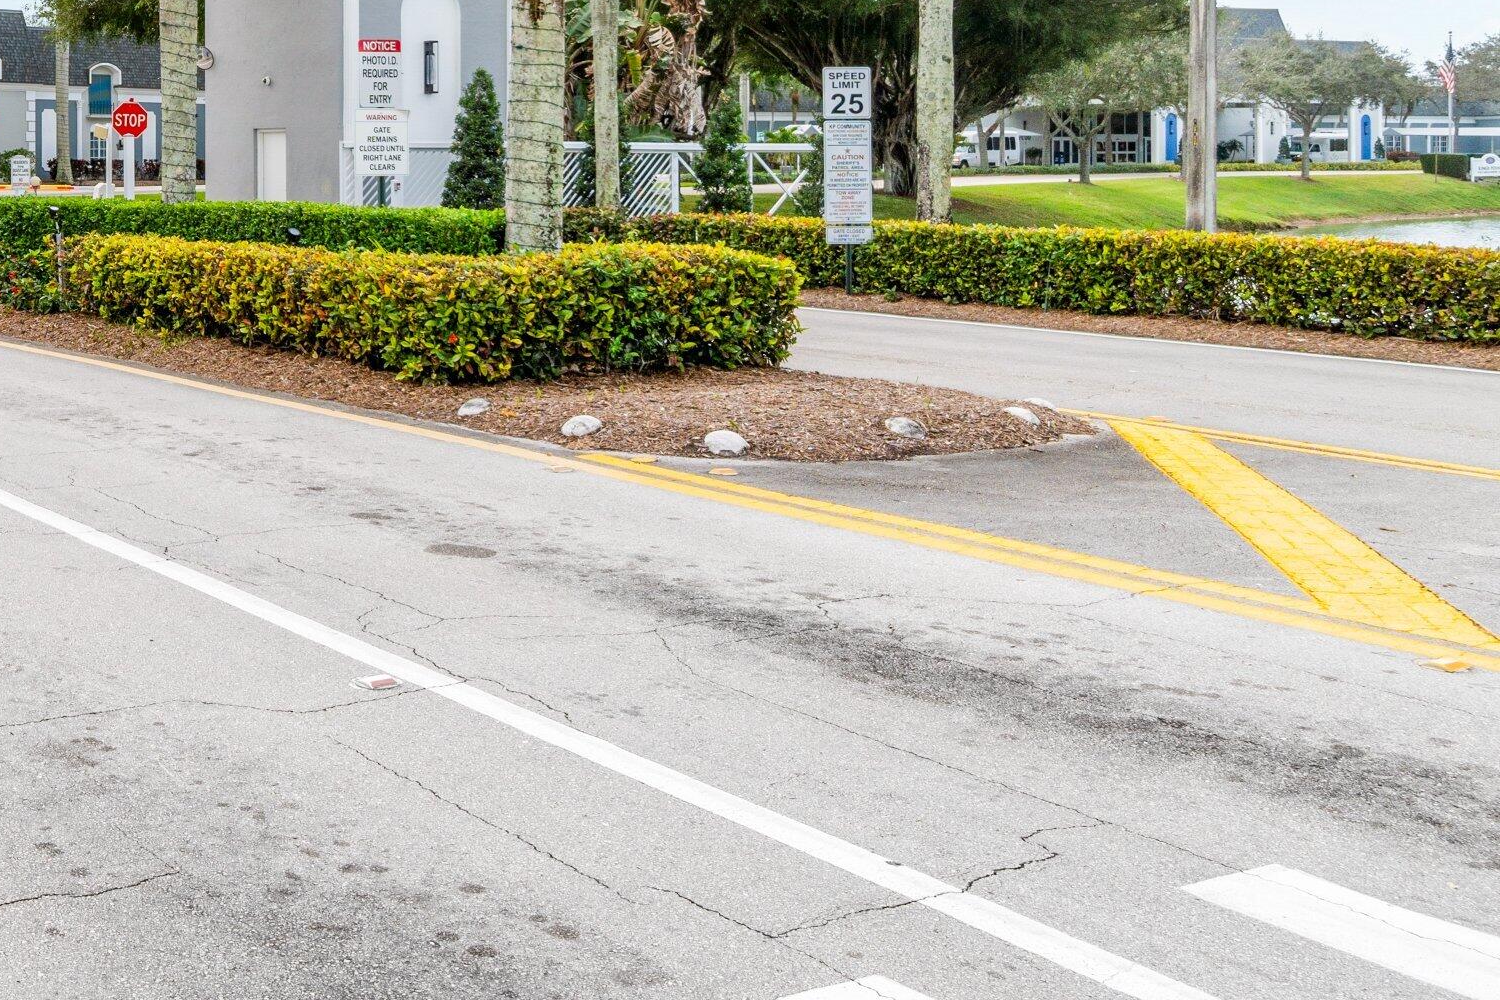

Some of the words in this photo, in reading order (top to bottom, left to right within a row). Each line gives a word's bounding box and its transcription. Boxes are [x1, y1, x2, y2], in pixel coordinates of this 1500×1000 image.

[362, 41, 397, 51] NOTICE
[361, 55, 387, 65] PHOTO
[387, 55, 399, 65] I.D.
[362, 68, 399, 78] REQUIRED
[373, 81, 388, 91] FOR
[369, 94, 392, 104] ENTRY
[831, 93, 864, 114] 25
[114, 113, 146, 127] STOP
[373, 126, 391, 134] GATE
[367, 135, 398, 143] REMAINS
[369, 163, 396, 171] CLEARS
